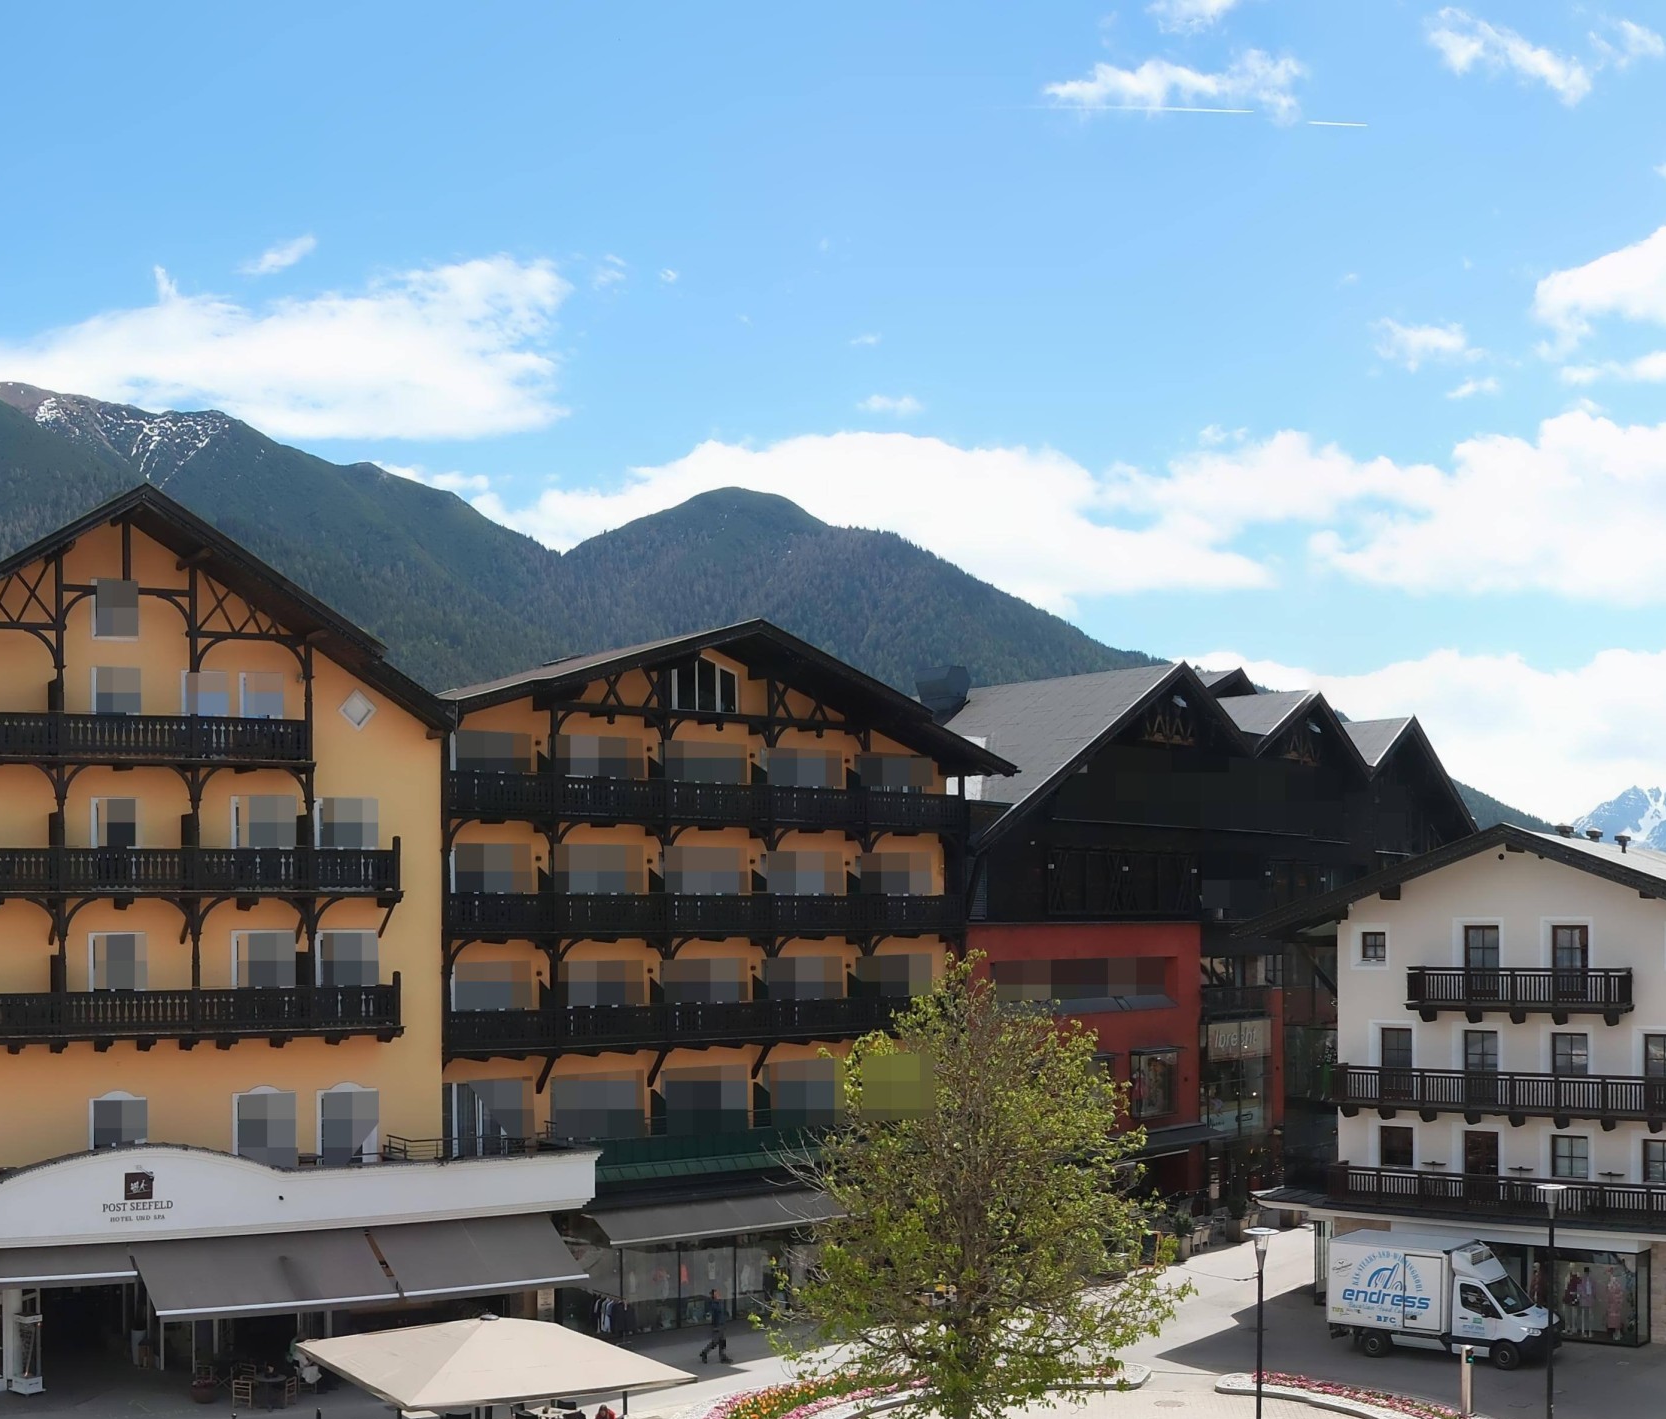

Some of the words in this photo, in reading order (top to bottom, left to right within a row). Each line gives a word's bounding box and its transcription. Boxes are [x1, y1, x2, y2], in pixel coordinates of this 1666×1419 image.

[102, 1202, 128, 1212] POST
[130, 1200, 173, 1211] SEEFELD
[1342, 1288, 1431, 1310] endress
[1376, 1315, 1397, 1324] BFC
